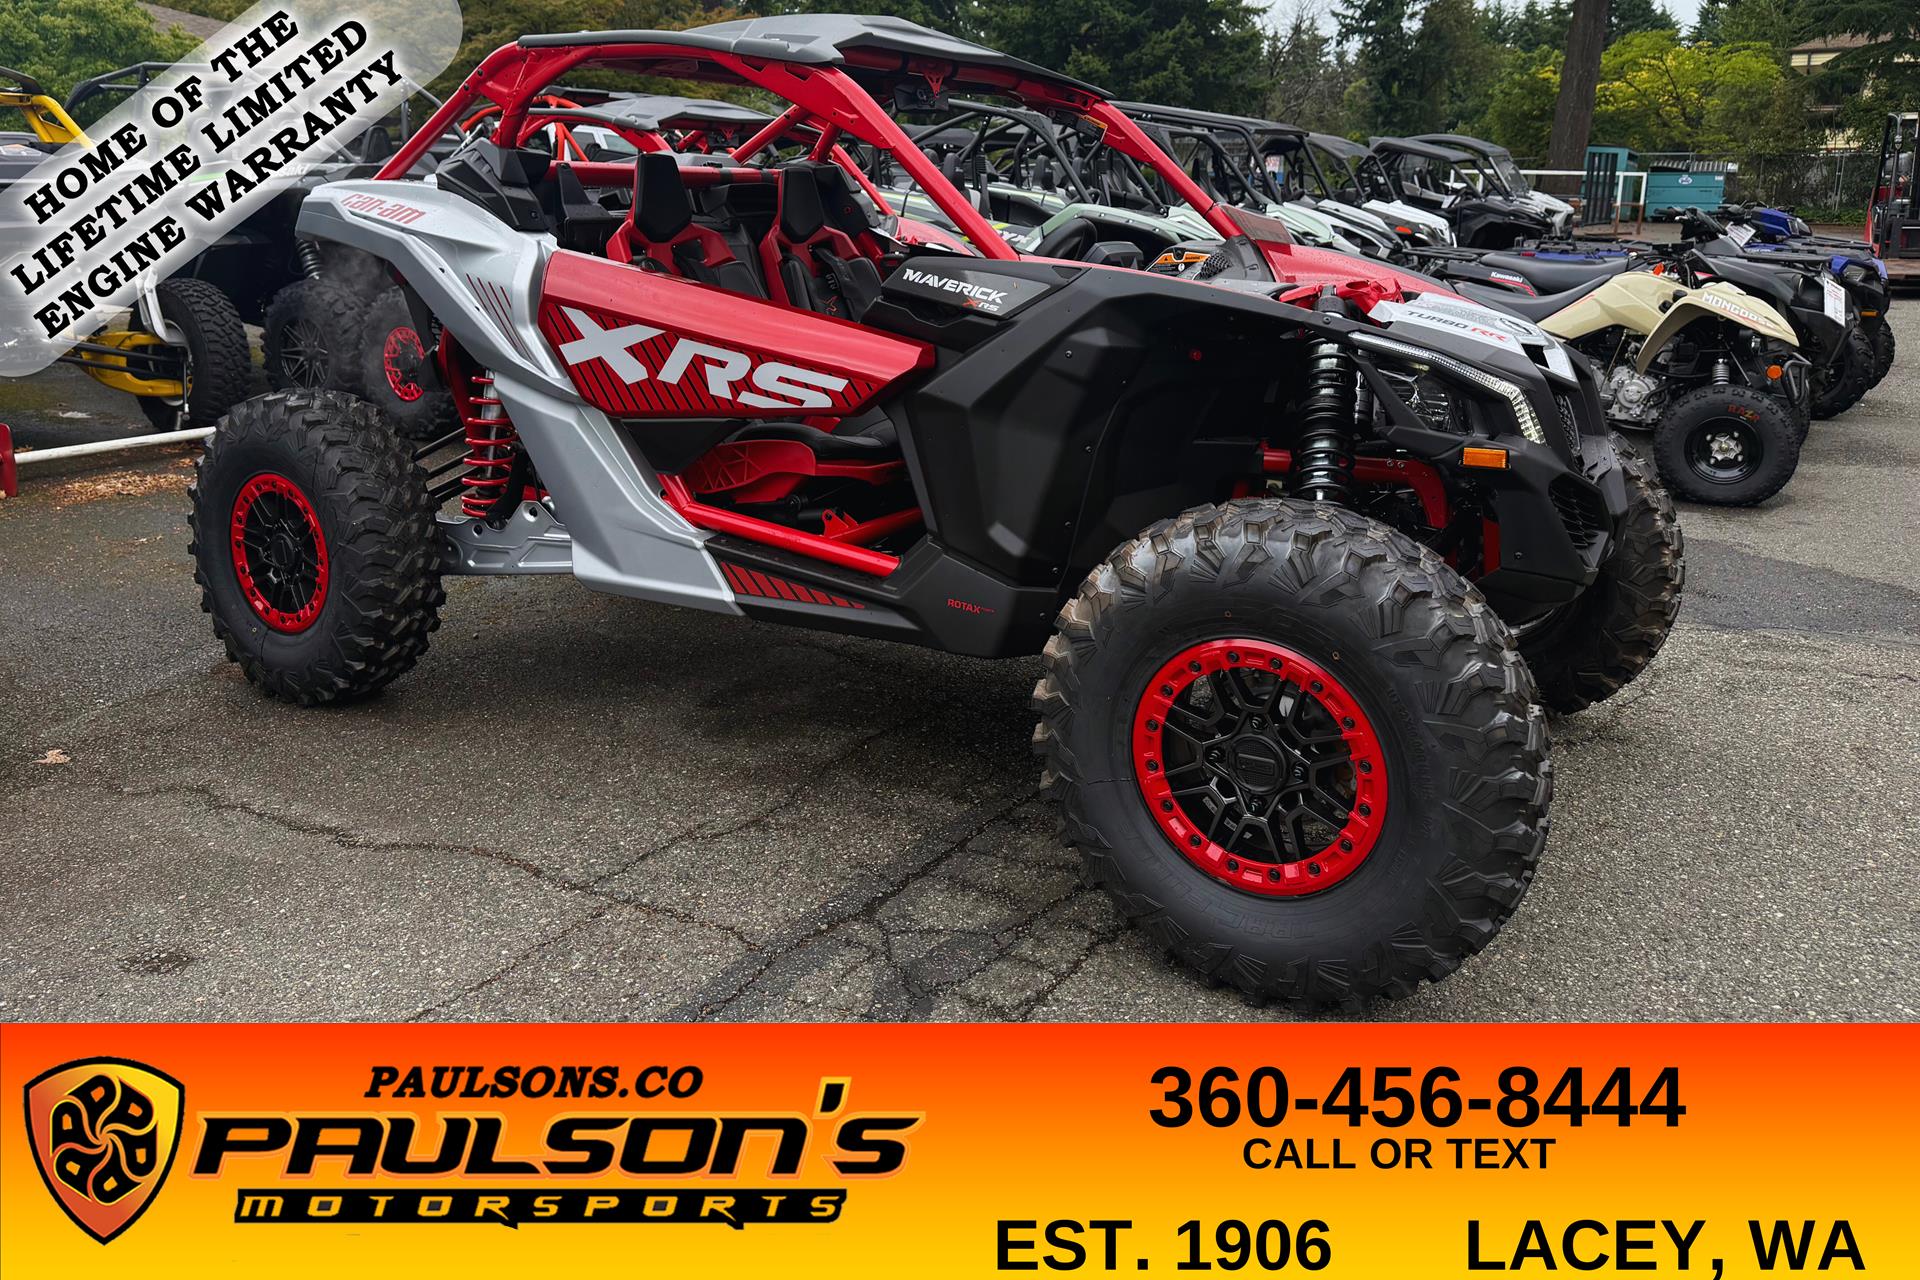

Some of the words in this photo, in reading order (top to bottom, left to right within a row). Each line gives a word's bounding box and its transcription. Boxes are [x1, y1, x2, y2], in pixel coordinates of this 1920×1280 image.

[903, 268, 1008, 304] MAVERICK
[1407, 310, 1469, 329] TURBO
[947, 598, 981, 614] ROTAX
